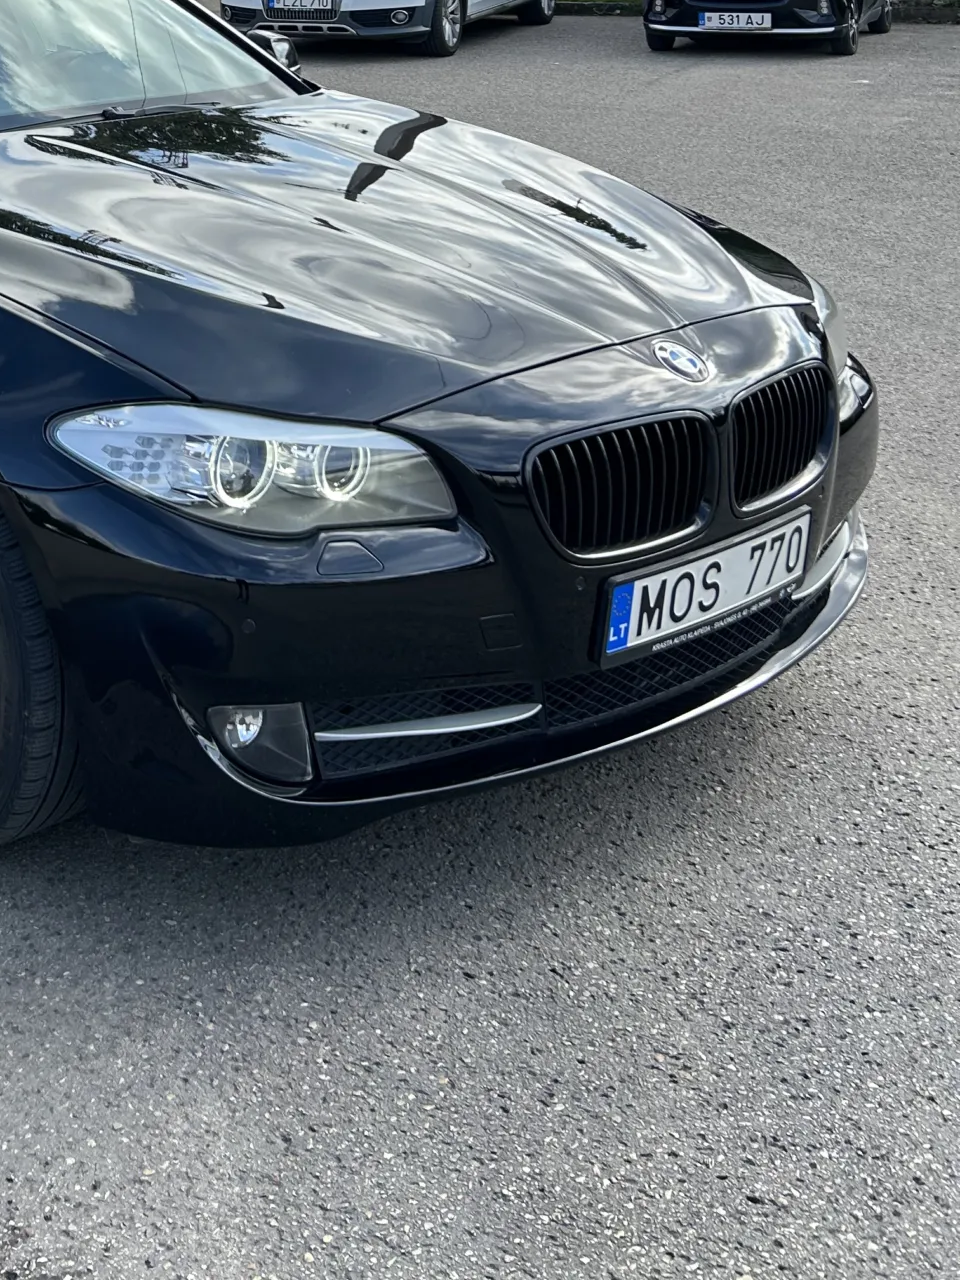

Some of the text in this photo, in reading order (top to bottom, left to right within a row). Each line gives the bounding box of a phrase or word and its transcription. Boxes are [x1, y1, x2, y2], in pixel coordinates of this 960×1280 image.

[718, 14, 765, 26] 531 AJ
[636, 525, 803, 637] MOS 770
[609, 622, 628, 642] LT
